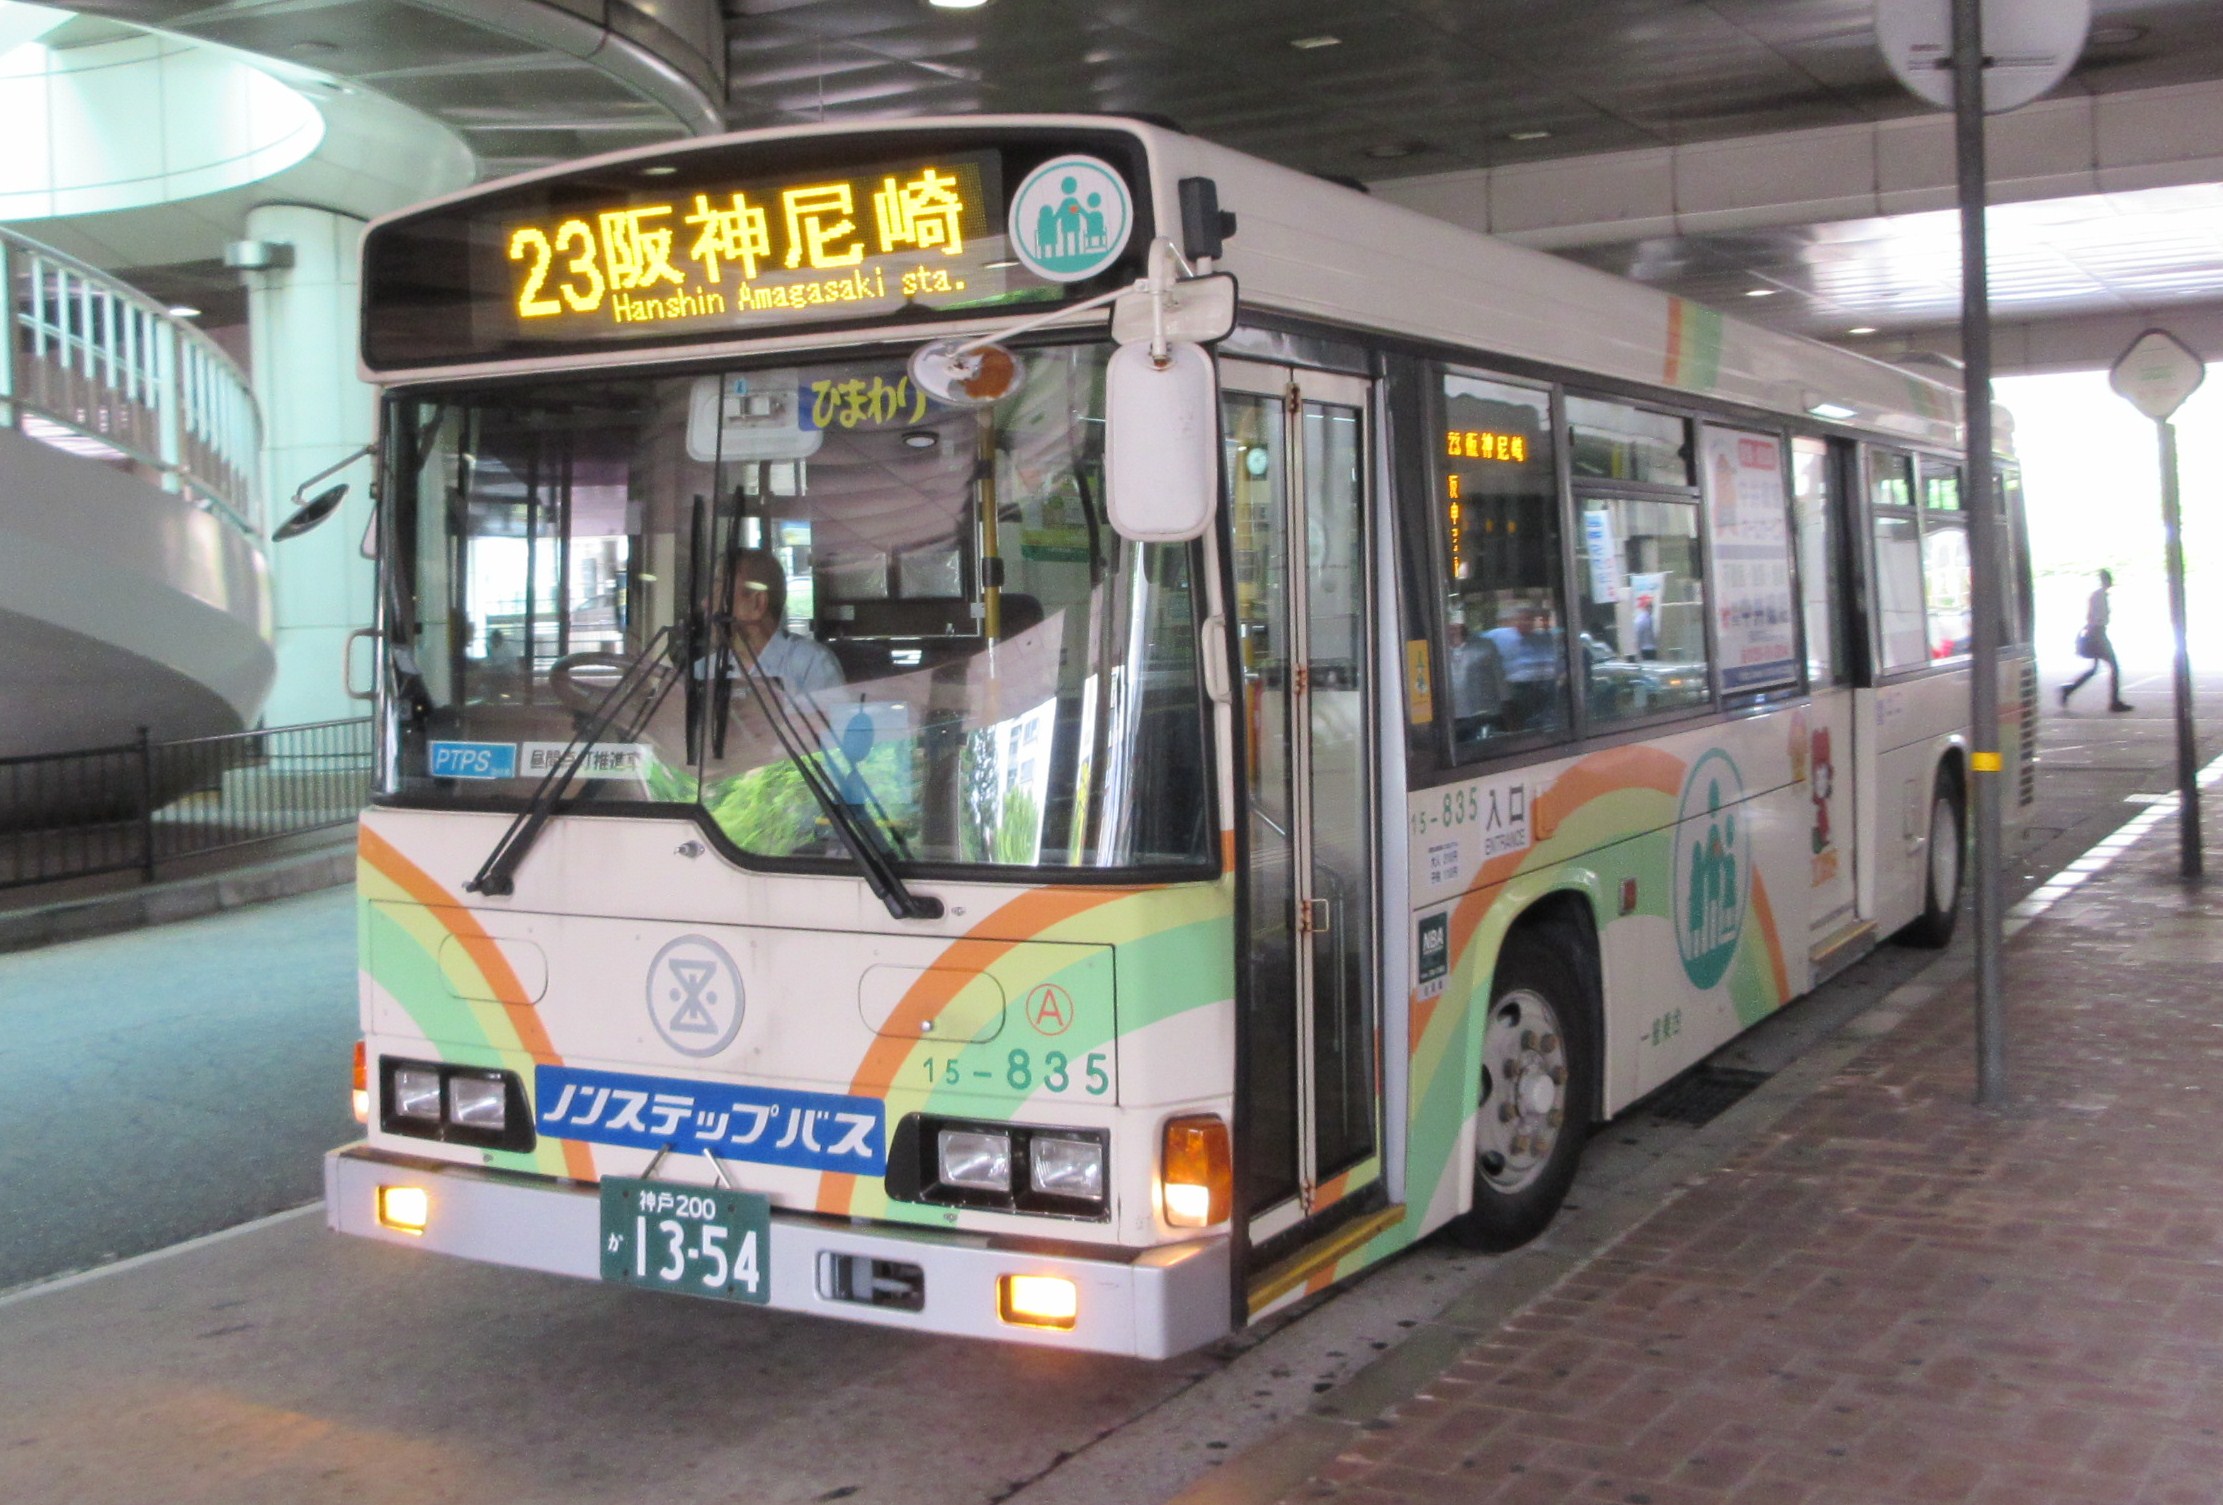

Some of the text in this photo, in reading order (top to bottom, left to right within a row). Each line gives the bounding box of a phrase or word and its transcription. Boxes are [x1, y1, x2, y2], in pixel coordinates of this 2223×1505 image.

[599, 168, 964, 292] 阪神尼崎
[612, 264, 966, 323] Hanshin Amagasaki sta.
[811, 376, 927, 428] ひまわり
[436, 749, 491, 772] PTPS
[1486, 784, 1524, 831] 入口
[1036, 988, 1064, 1026] A
[543, 1084, 876, 1158] ノンステップバス
[608, 1232, 624, 1252] か
